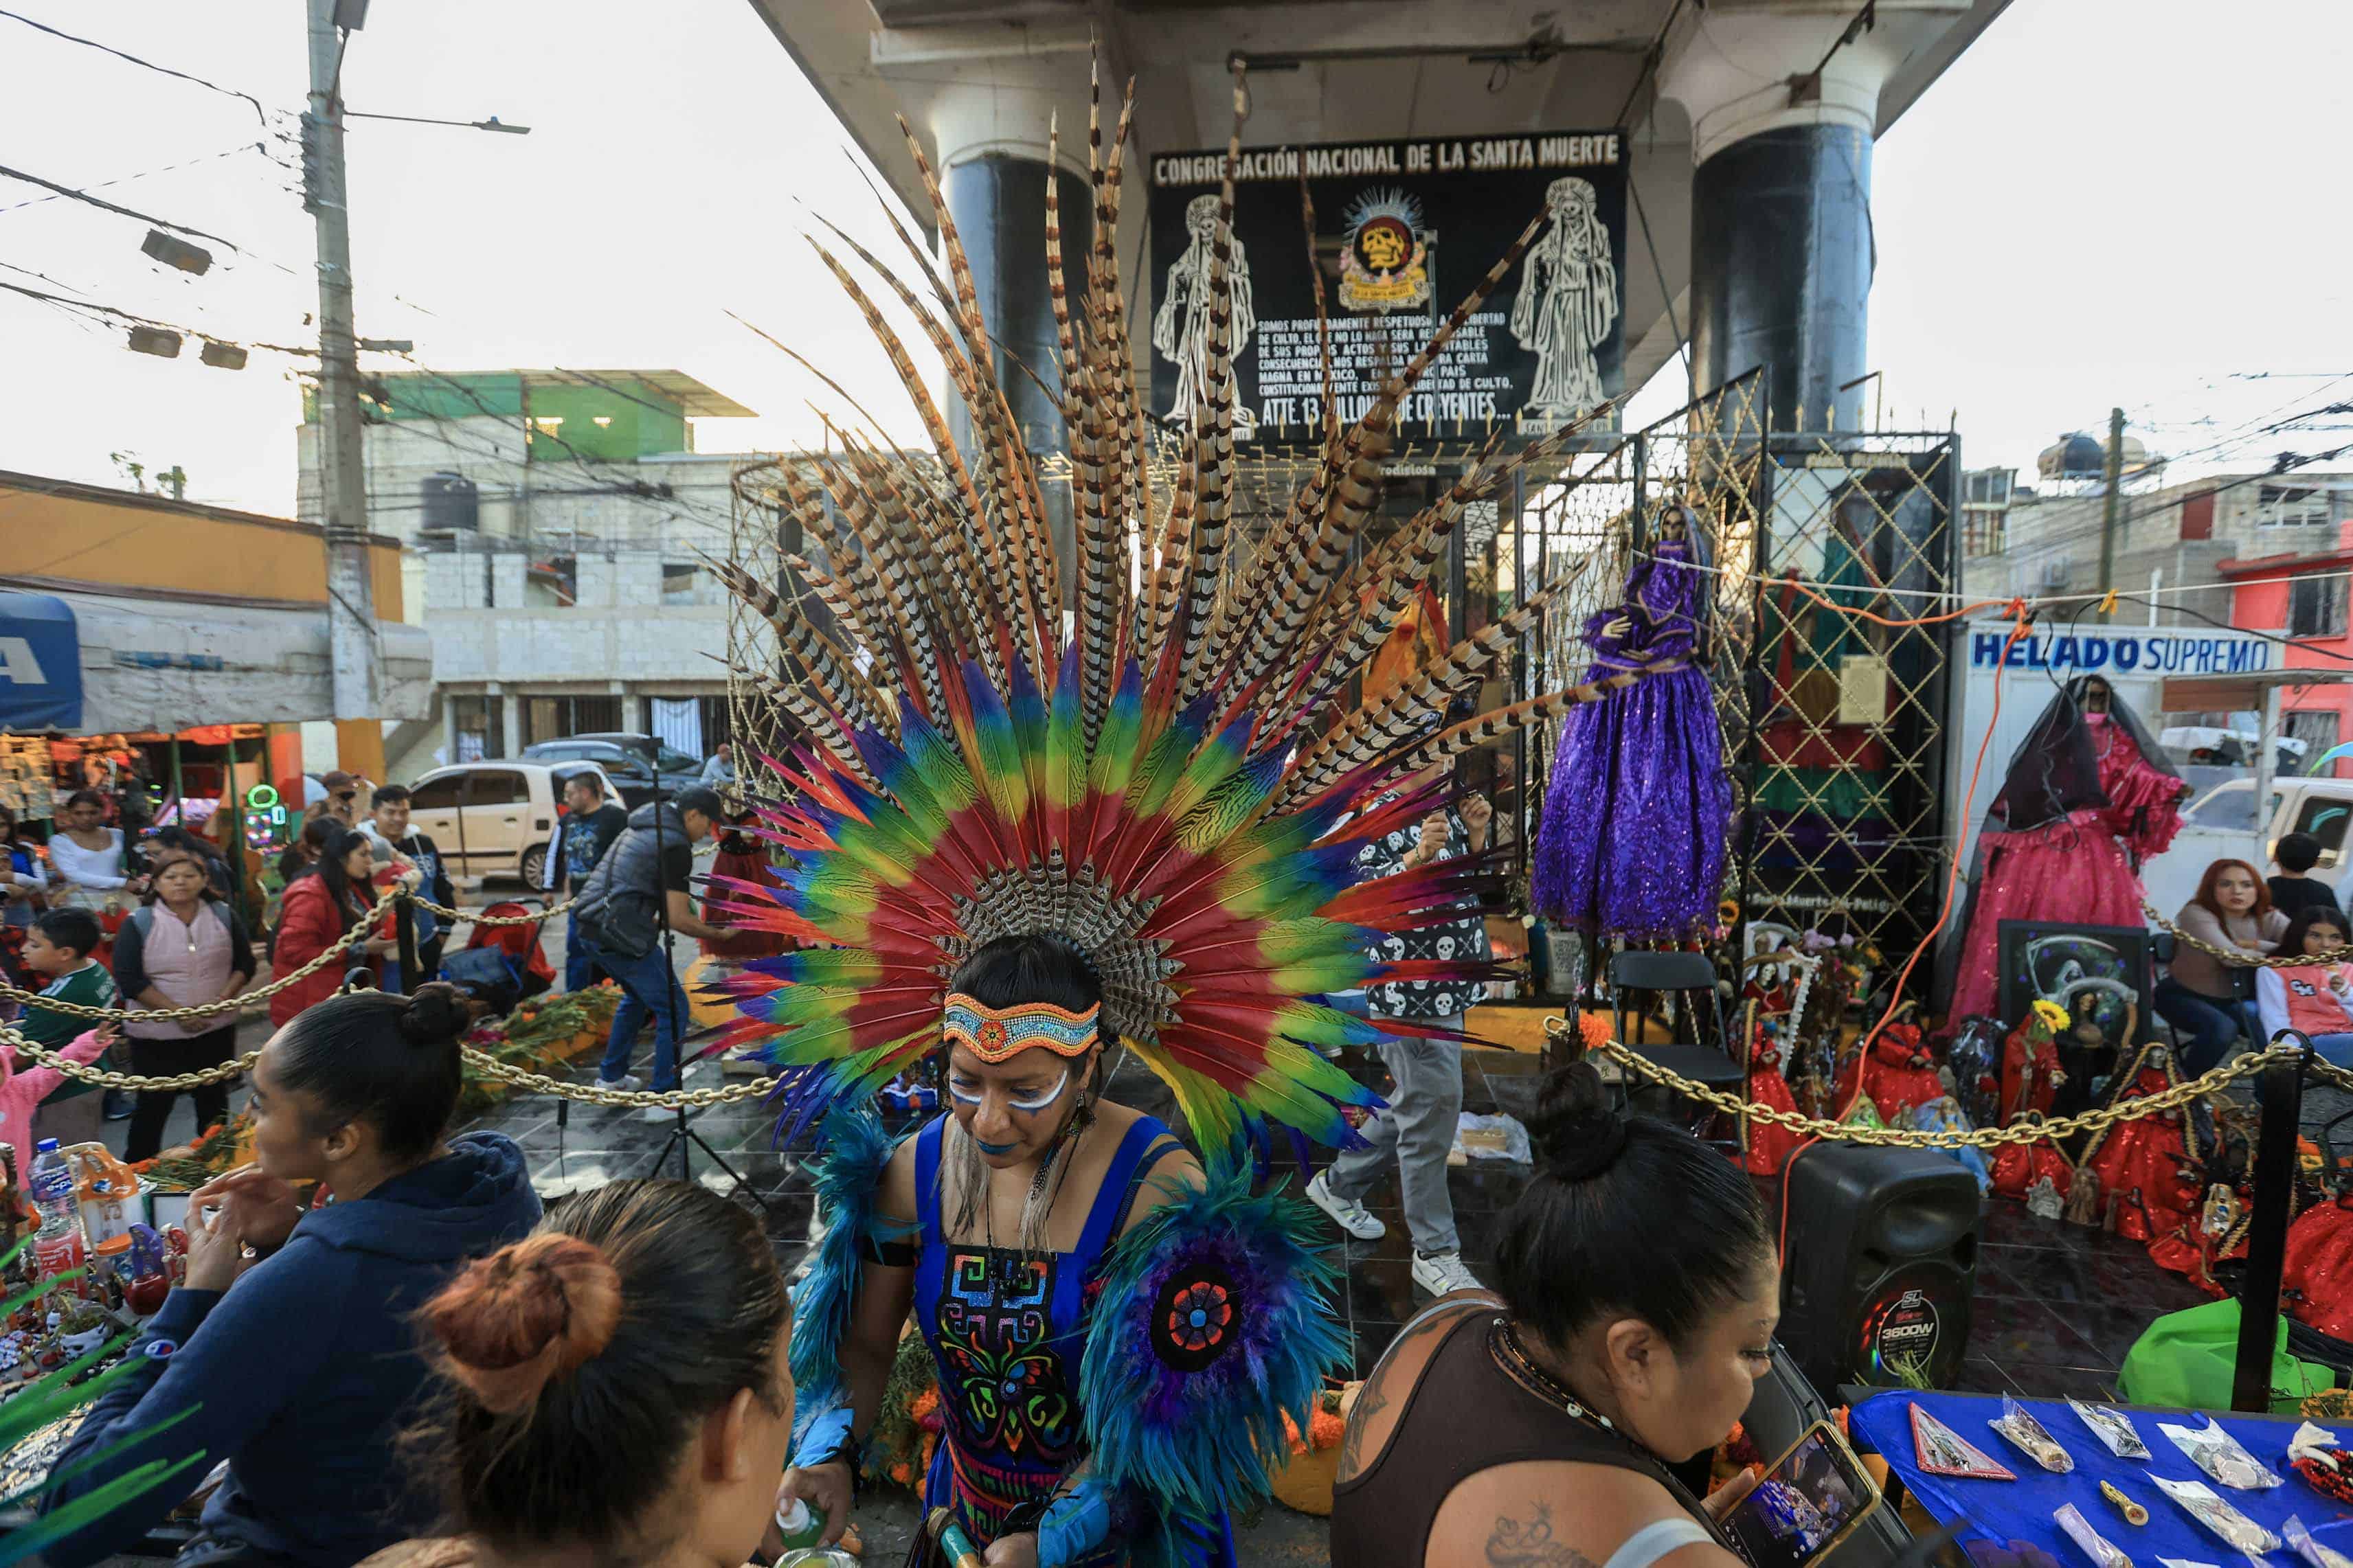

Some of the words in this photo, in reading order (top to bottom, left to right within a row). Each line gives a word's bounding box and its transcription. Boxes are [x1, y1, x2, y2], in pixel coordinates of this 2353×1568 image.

[1306, 145, 1400, 175] NACIONAL
[1407, 144, 1431, 170] DE
[1439, 141, 1465, 169] LA
[1470, 139, 1534, 168] SANTA
[1540, 135, 1619, 163] MUERTE
[1258, 320, 1290, 332] SOMOS
[1292, 319, 1369, 332] PROFUDAMENTE
[1258, 334, 1270, 345] DE
[1304, 332, 1314, 343] EL
[1335, 331, 1348, 343] NO
[1351, 330, 1362, 342] LO
[1258, 347, 1270, 358] DE
[1273, 345, 1292, 357] SUS
[1295, 344, 1337, 357] PROPS
[1343, 343, 1375, 356] ACTOS
[1380, 343, 1386, 354] Y
[1391, 342, 1409, 354] SUS
[1333, 357, 1352, 368] NOS
[1456, 352, 1488, 364] CARTA
[1259, 371, 1293, 383] MAGNA
[1297, 370, 1311, 382] EN
[1314, 370, 1359, 381] MXICO.
[1459, 378, 1471, 389] DE
[1262, 397, 1301, 426] ATTE.
[1301, 397, 1320, 424] 13
[1378, 464, 1437, 477] rodigiosa
[1973, 633, 2139, 671] HELADO
[2143, 637, 2268, 673] SUPREMO
[1882, 1323, 1935, 1339] 3600W
